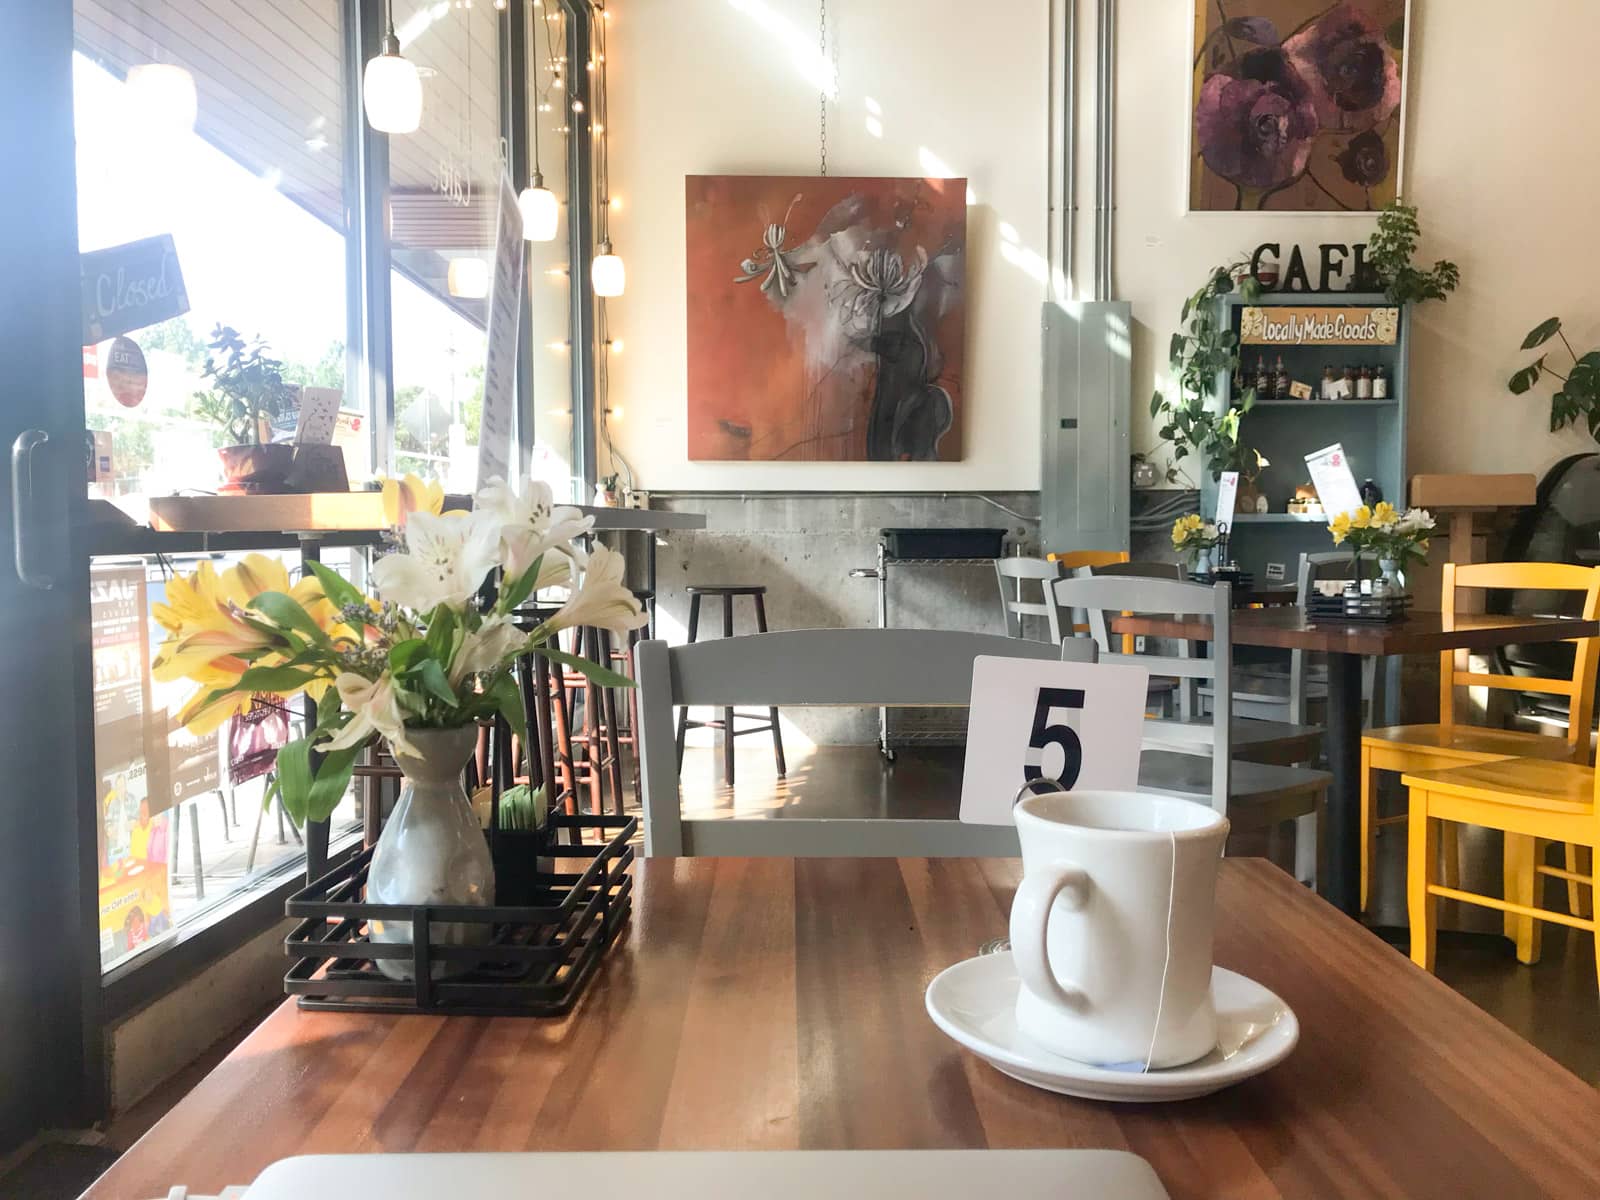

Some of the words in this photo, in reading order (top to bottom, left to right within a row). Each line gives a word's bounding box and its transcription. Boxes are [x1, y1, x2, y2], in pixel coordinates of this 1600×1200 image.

[96, 253, 173, 317] Closed
[1262, 313, 1304, 345] Locally
[1304, 315, 1334, 341] Made
[1335, 313, 1376, 341] Goods
[1023, 686, 1086, 796] 5
